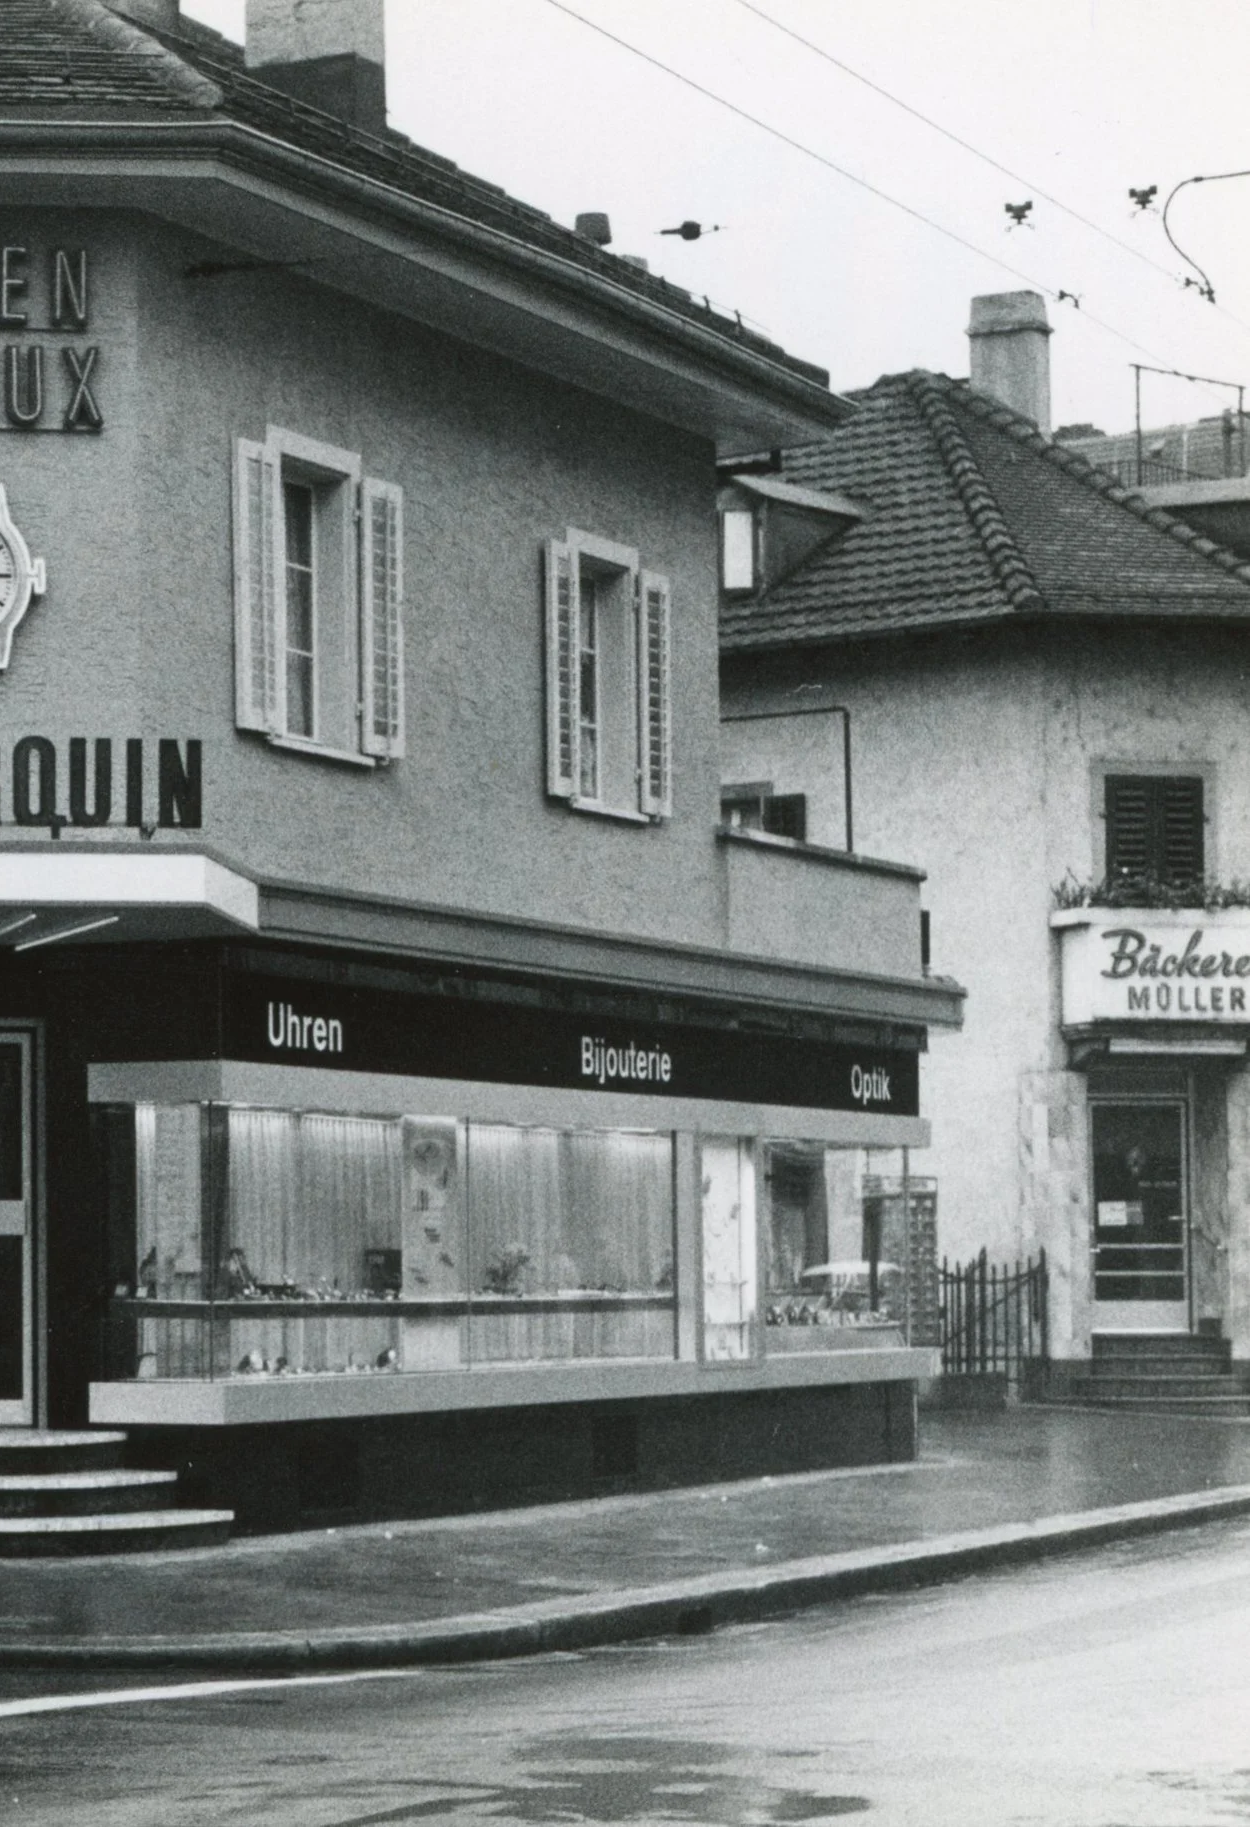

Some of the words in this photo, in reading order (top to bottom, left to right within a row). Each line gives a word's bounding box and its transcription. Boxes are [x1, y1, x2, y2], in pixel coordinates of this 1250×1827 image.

[1127, 982, 1246, 1012] MÜLLER
[267, 1002, 343, 1053] Uhren
[580, 1035, 672, 1083] Bijouterie
[850, 1064, 892, 1103] Optik
